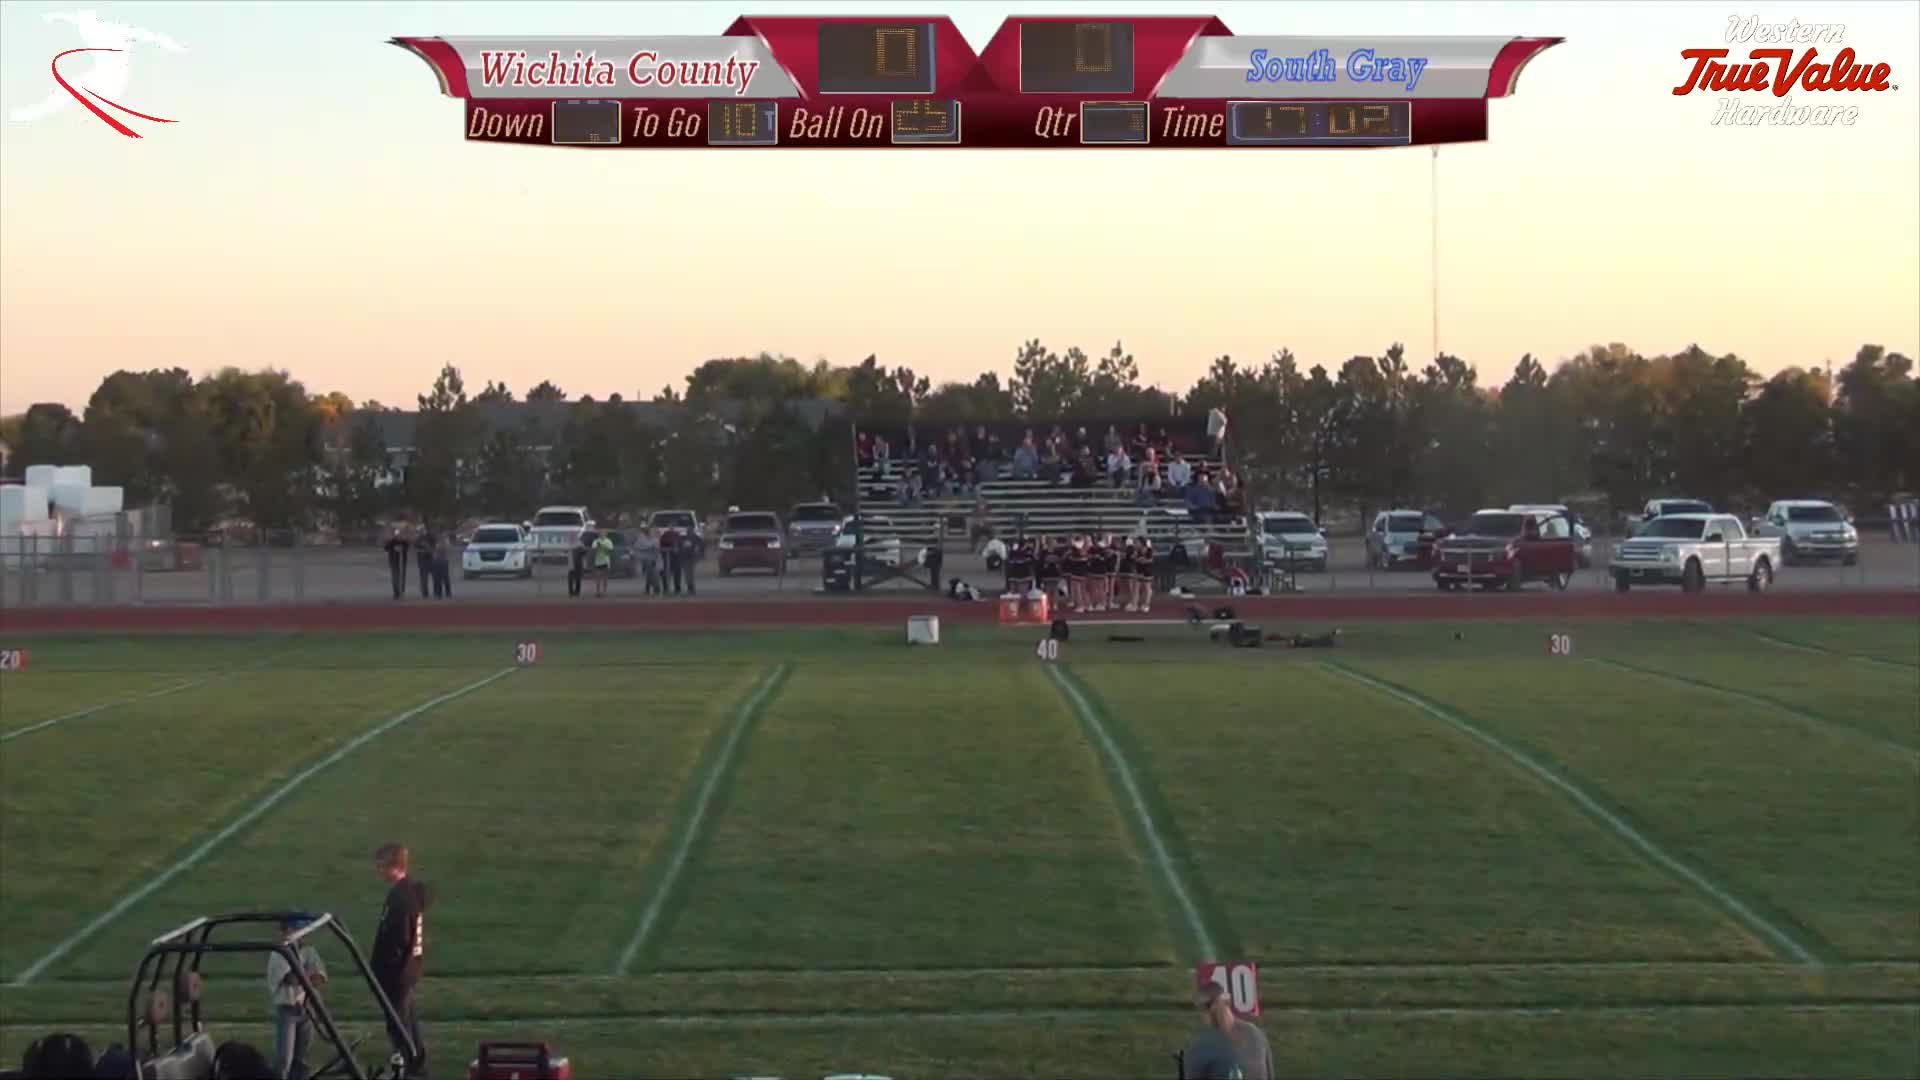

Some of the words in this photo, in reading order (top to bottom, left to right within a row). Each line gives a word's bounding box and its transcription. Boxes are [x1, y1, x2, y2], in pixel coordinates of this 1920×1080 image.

[517, 643, 537, 662] 30
[1037, 638, 1058, 660] 40
[1551, 634, 1570, 655] 30
[0, 650, 20, 669] 20
